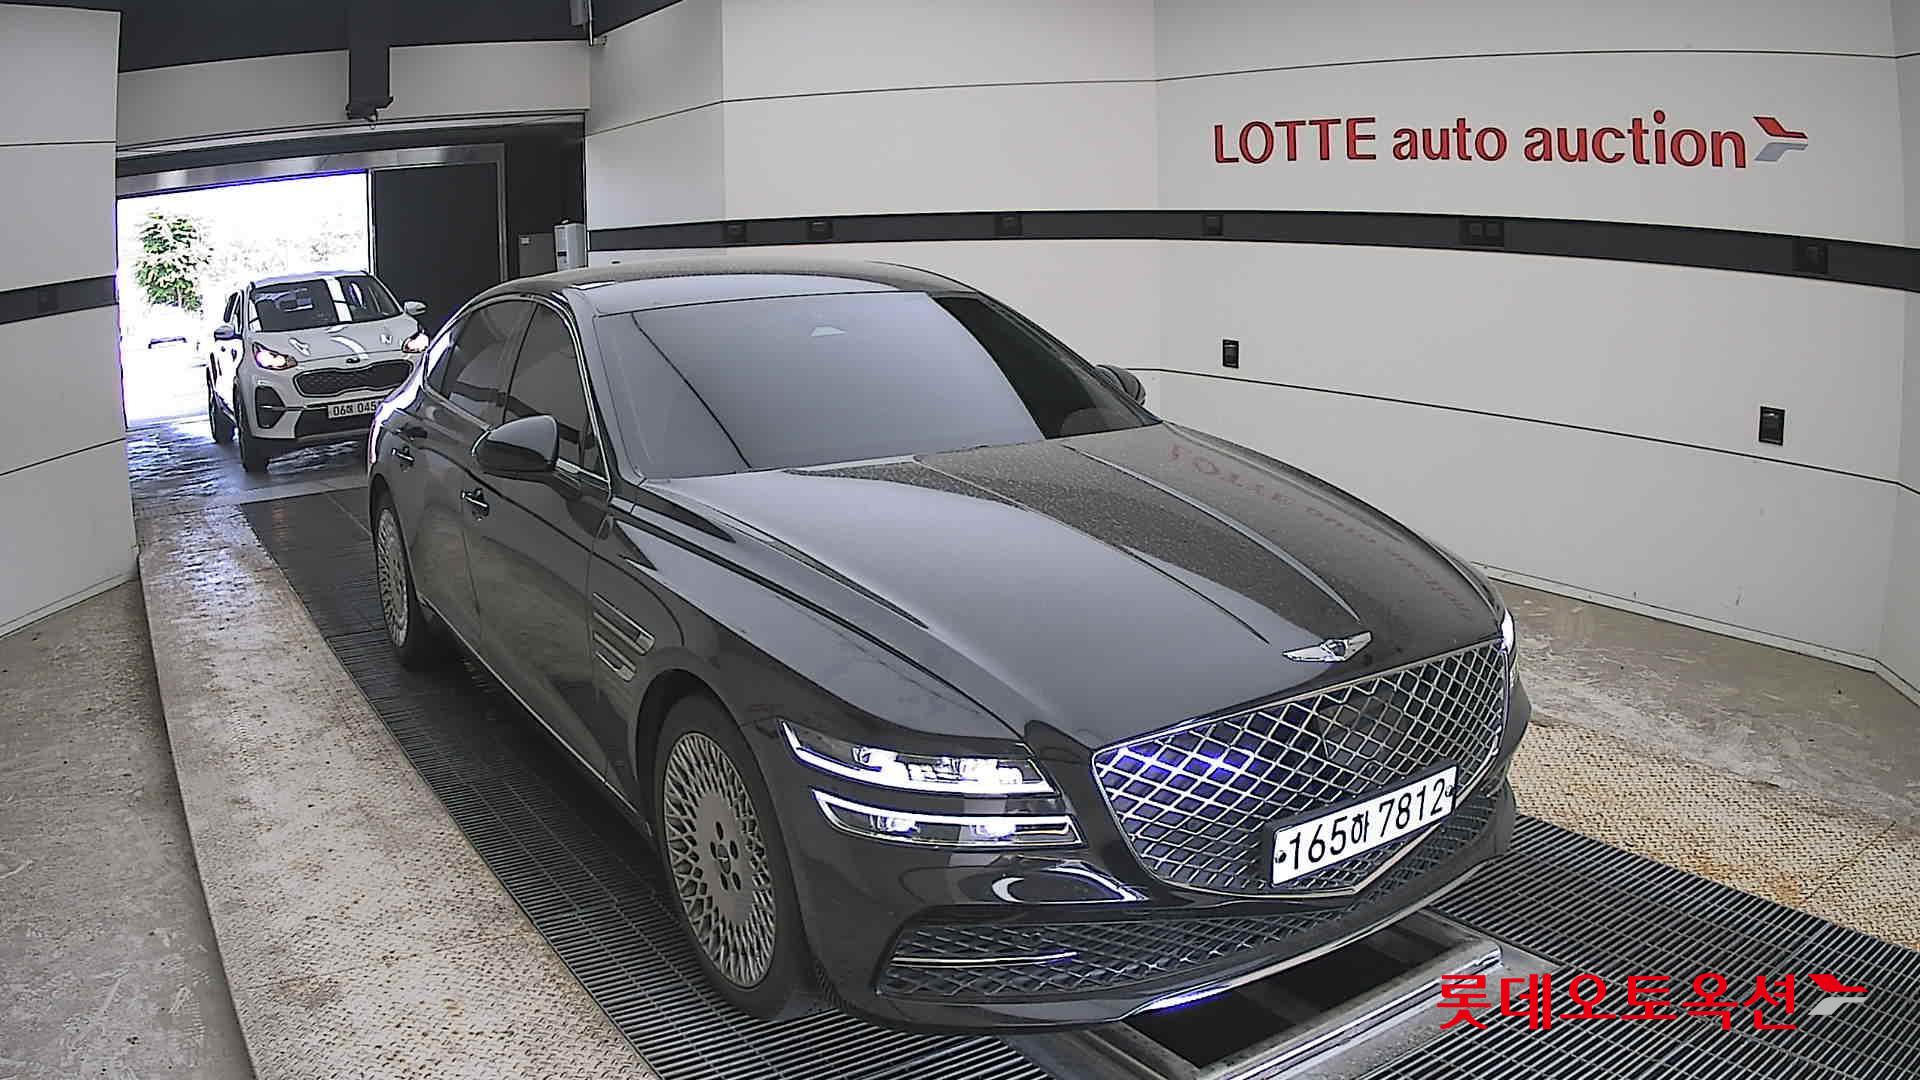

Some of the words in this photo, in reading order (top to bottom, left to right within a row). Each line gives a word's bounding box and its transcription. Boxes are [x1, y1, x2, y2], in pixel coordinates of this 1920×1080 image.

[1213, 116, 1377, 165] LOTTE
[1392, 117, 1508, 162] auto
[1523, 109, 1748, 169] auction
[357, 400, 380, 413] 045
[1289, 810, 1370, 870] 165하
[1379, 778, 1446, 838] 7812
